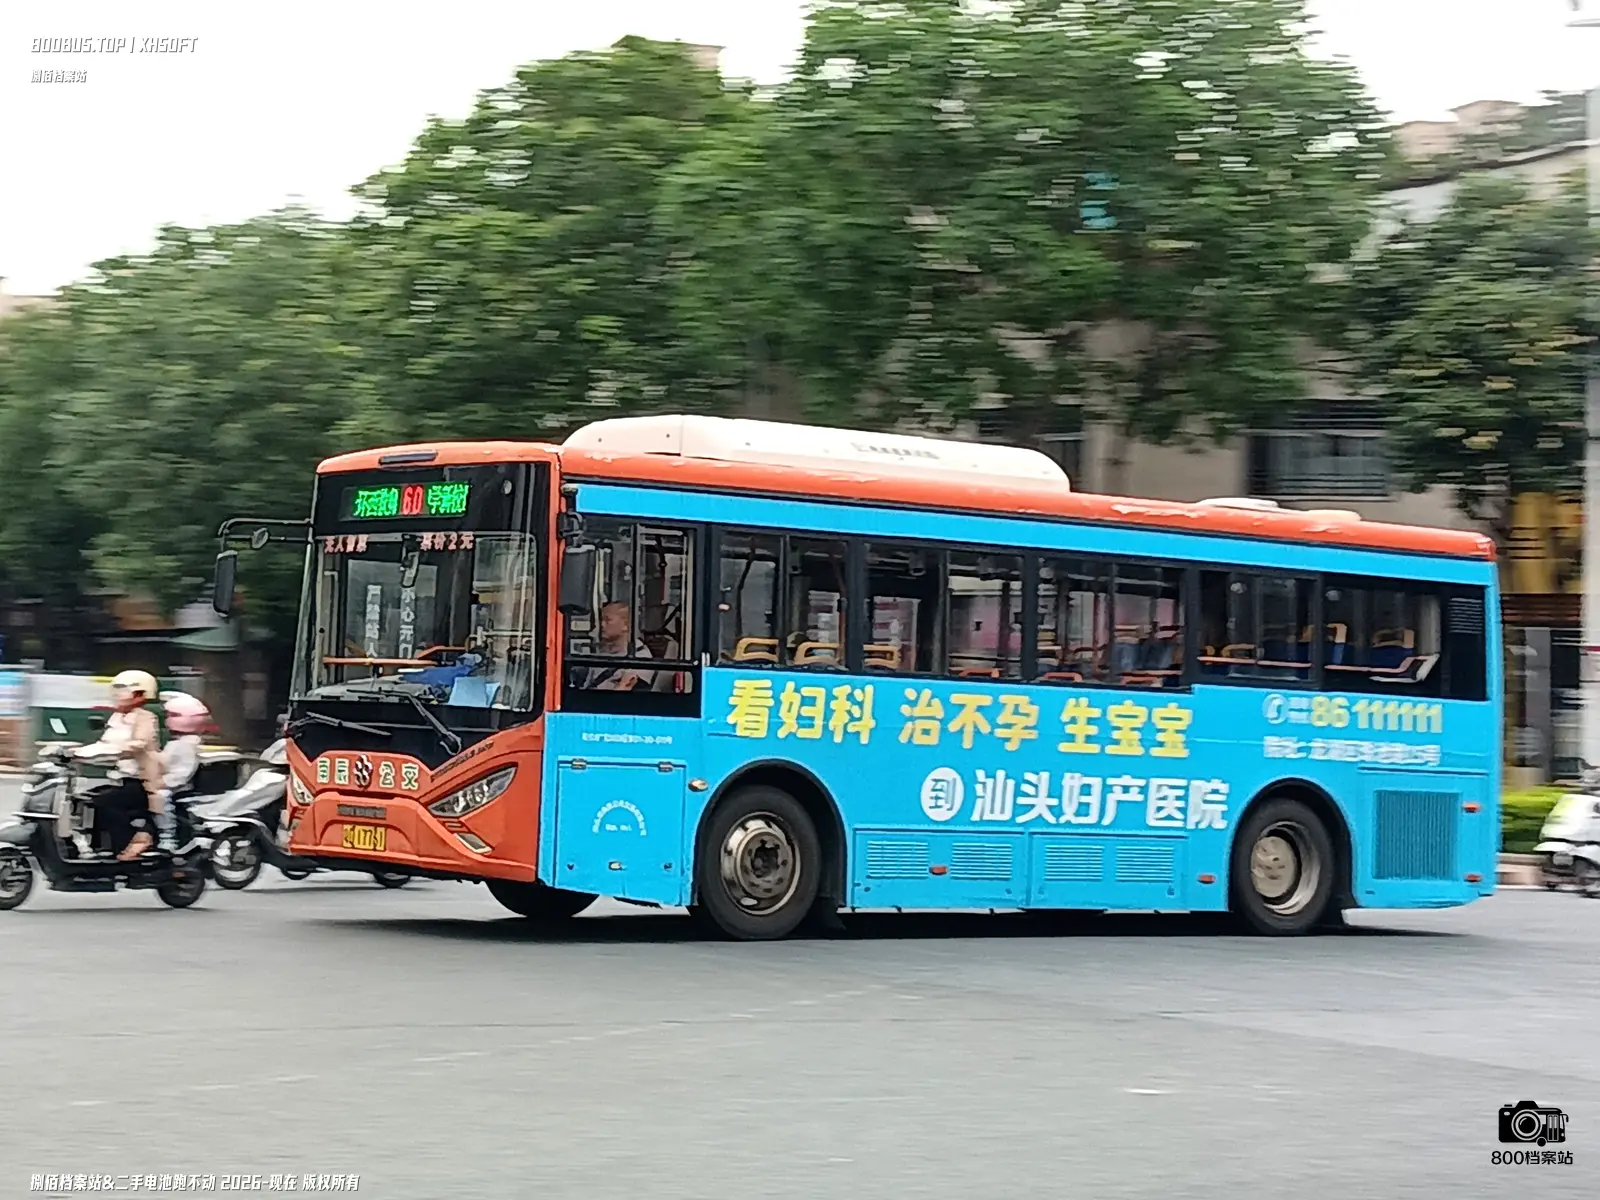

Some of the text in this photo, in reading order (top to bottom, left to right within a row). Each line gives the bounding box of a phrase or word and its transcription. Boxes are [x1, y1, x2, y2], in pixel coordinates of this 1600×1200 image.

[402, 485, 424, 515] 60
[726, 678, 877, 745] 看妇科
[898, 688, 1040, 752] 治不孕
[1058, 697, 1193, 758] 生宝宝
[929, 768, 1231, 831] 到 汕头妇产医院
